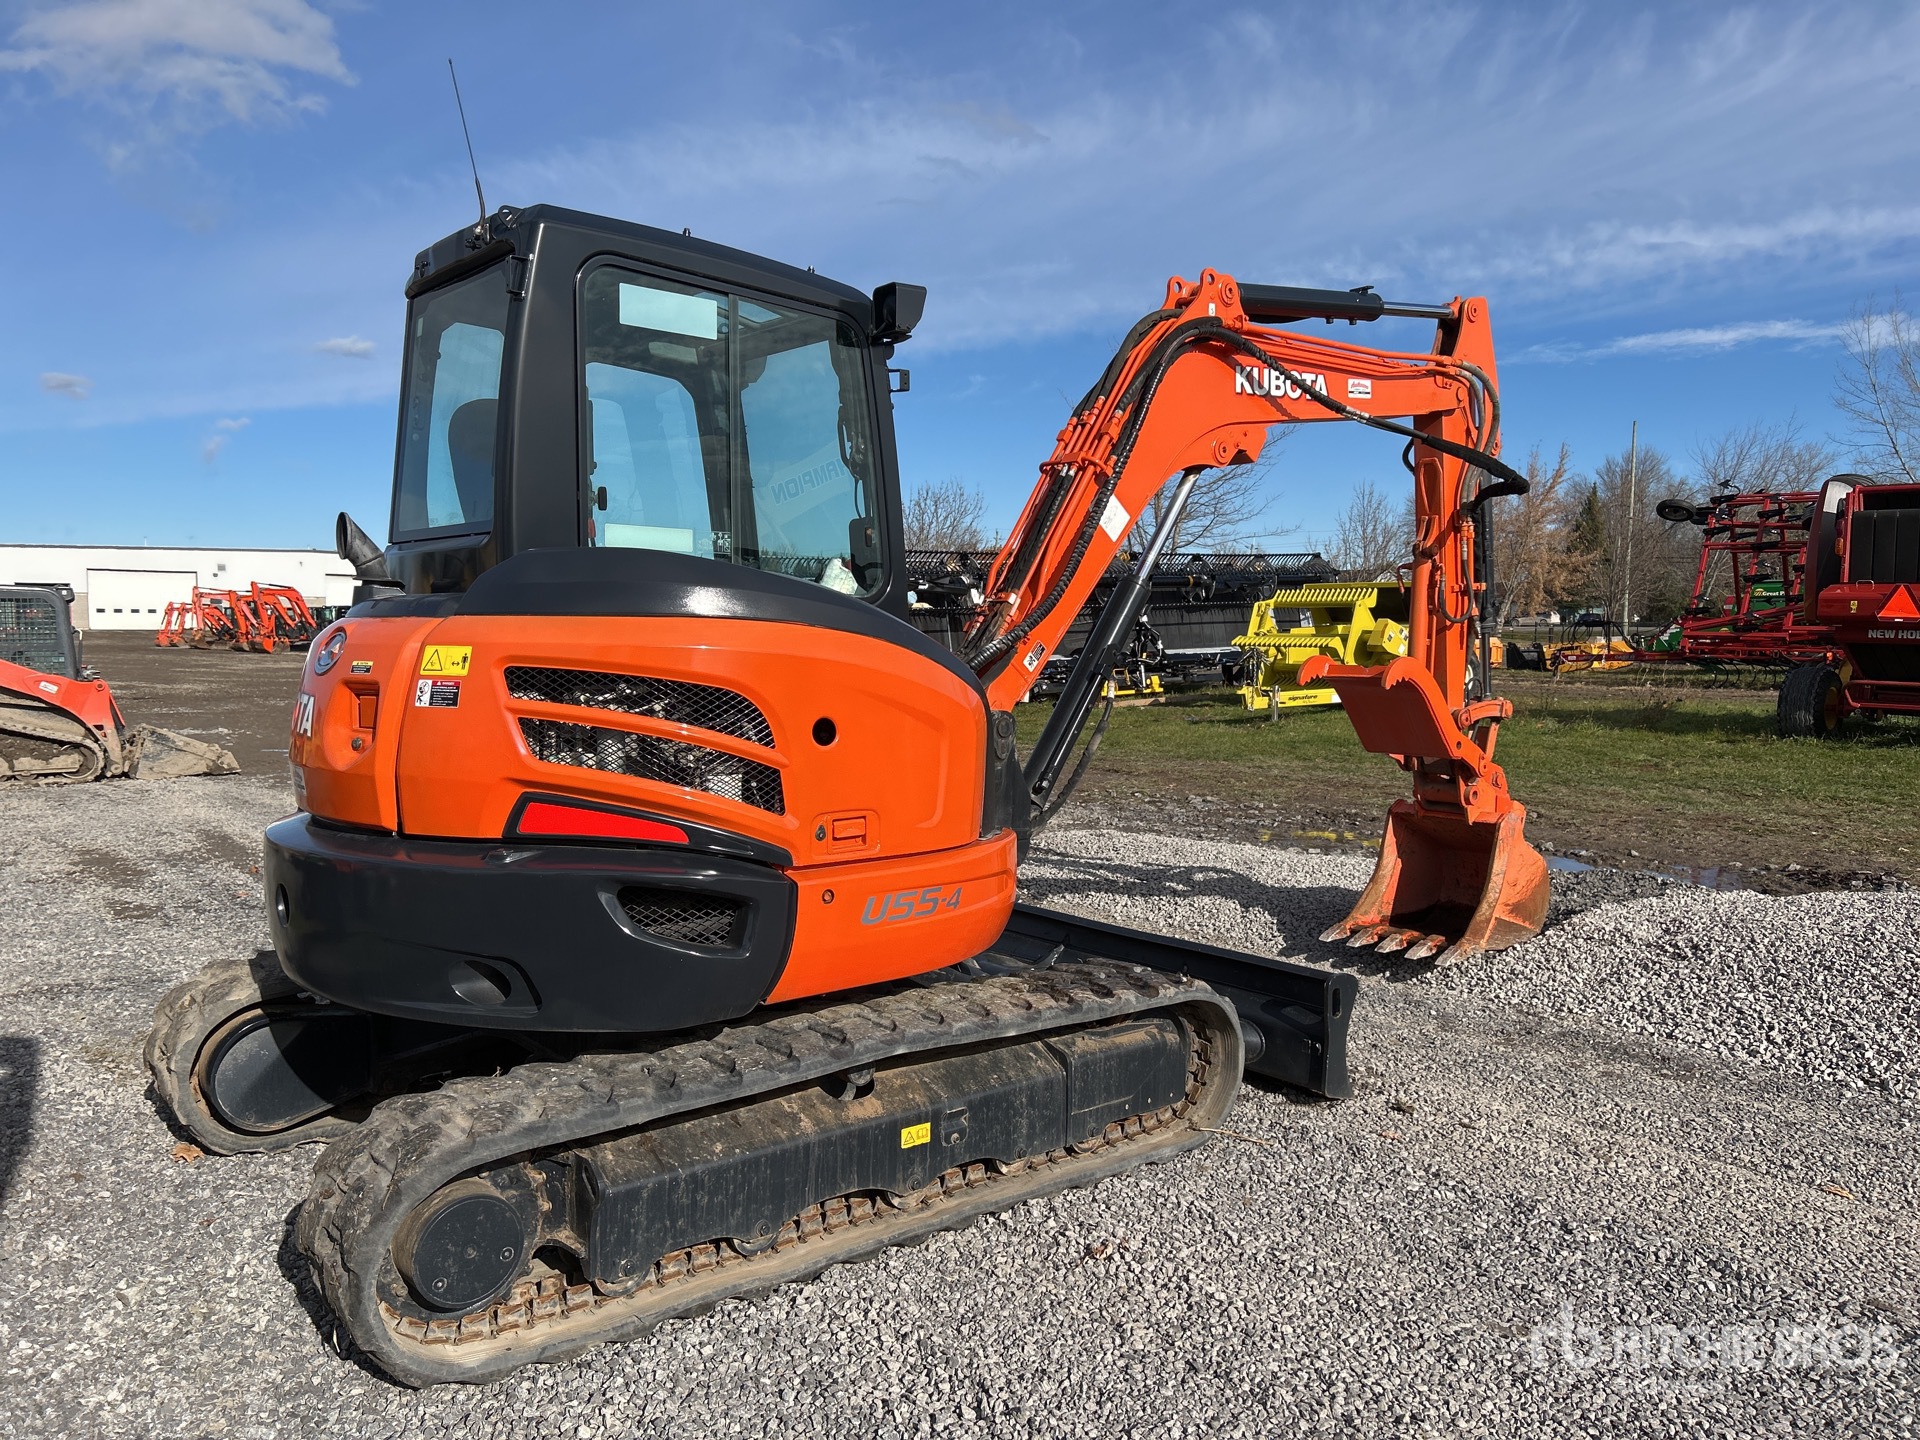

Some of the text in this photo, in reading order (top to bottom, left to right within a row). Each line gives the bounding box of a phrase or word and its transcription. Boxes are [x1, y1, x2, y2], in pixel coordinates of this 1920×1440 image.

[1235, 365, 1328, 400] KUBOTA
[1868, 629, 1896, 639] NEW
[861, 886, 962, 925] U55-4
